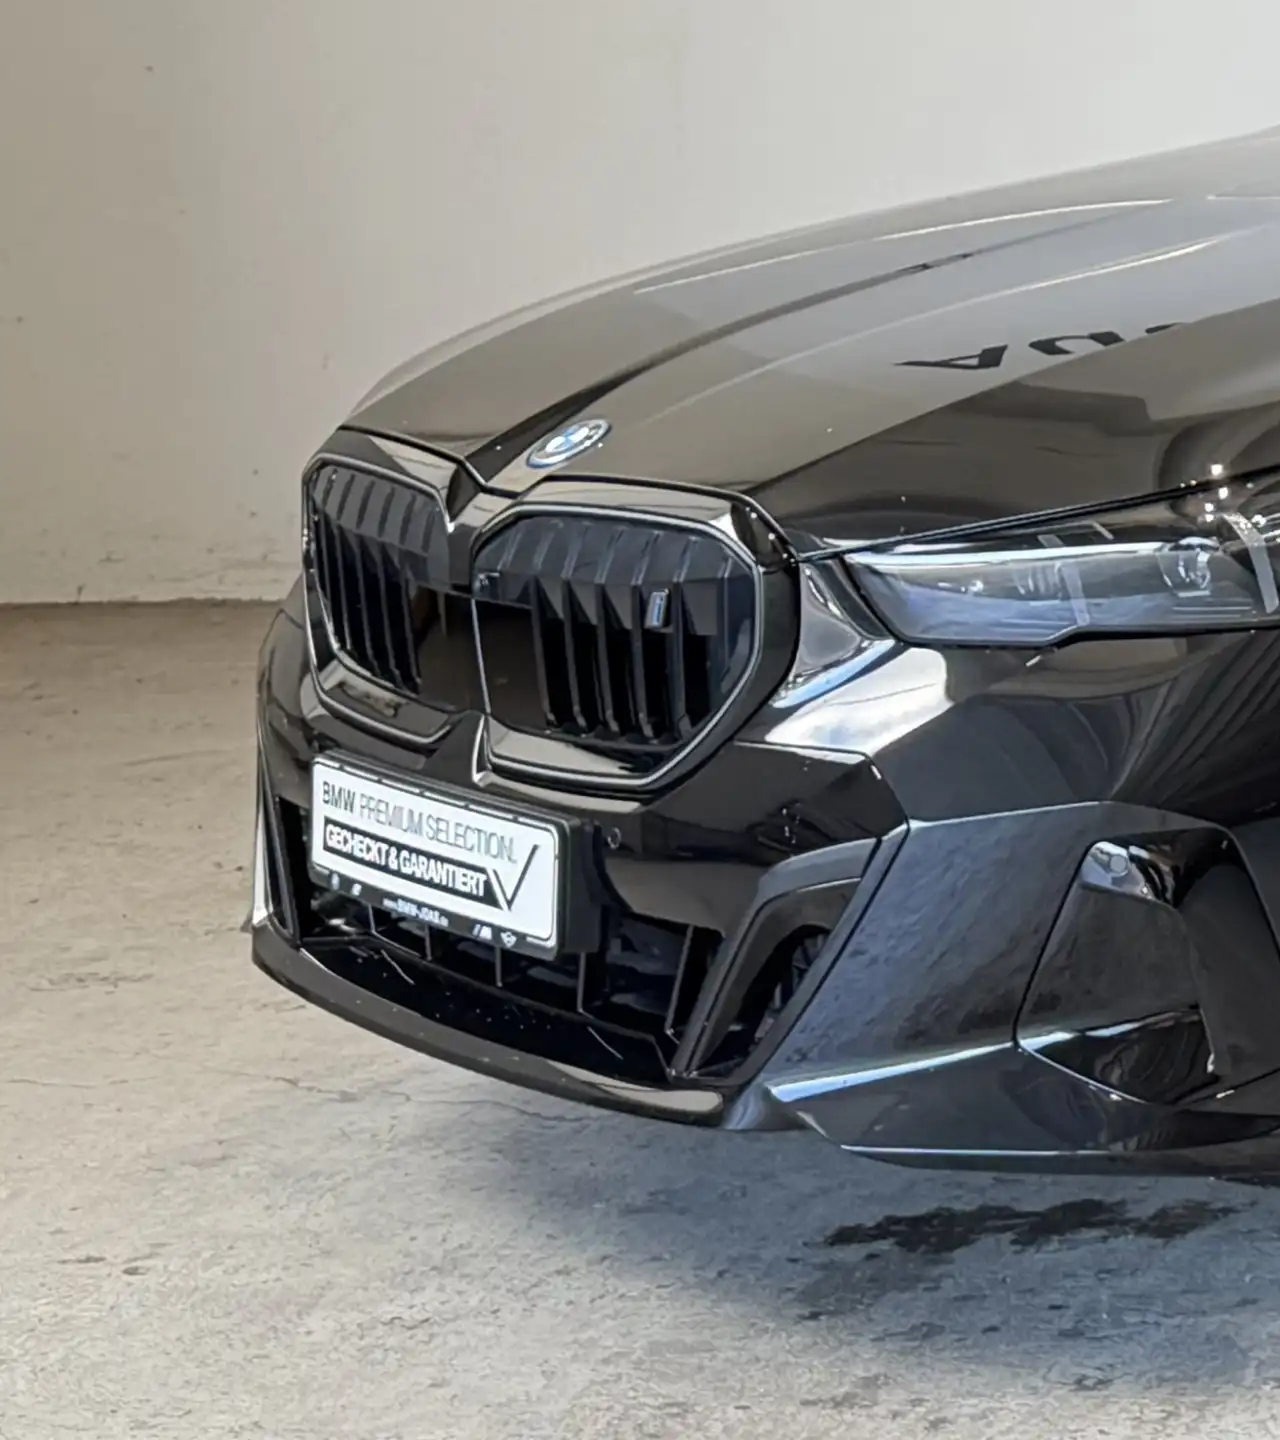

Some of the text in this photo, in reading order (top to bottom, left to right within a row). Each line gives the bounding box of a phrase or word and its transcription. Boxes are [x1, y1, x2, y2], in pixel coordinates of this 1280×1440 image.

[323, 780, 356, 814] BMW
[359, 792, 424, 837] PREMIUM
[326, 823, 488, 897] GECHECKT & GARANTIERT
